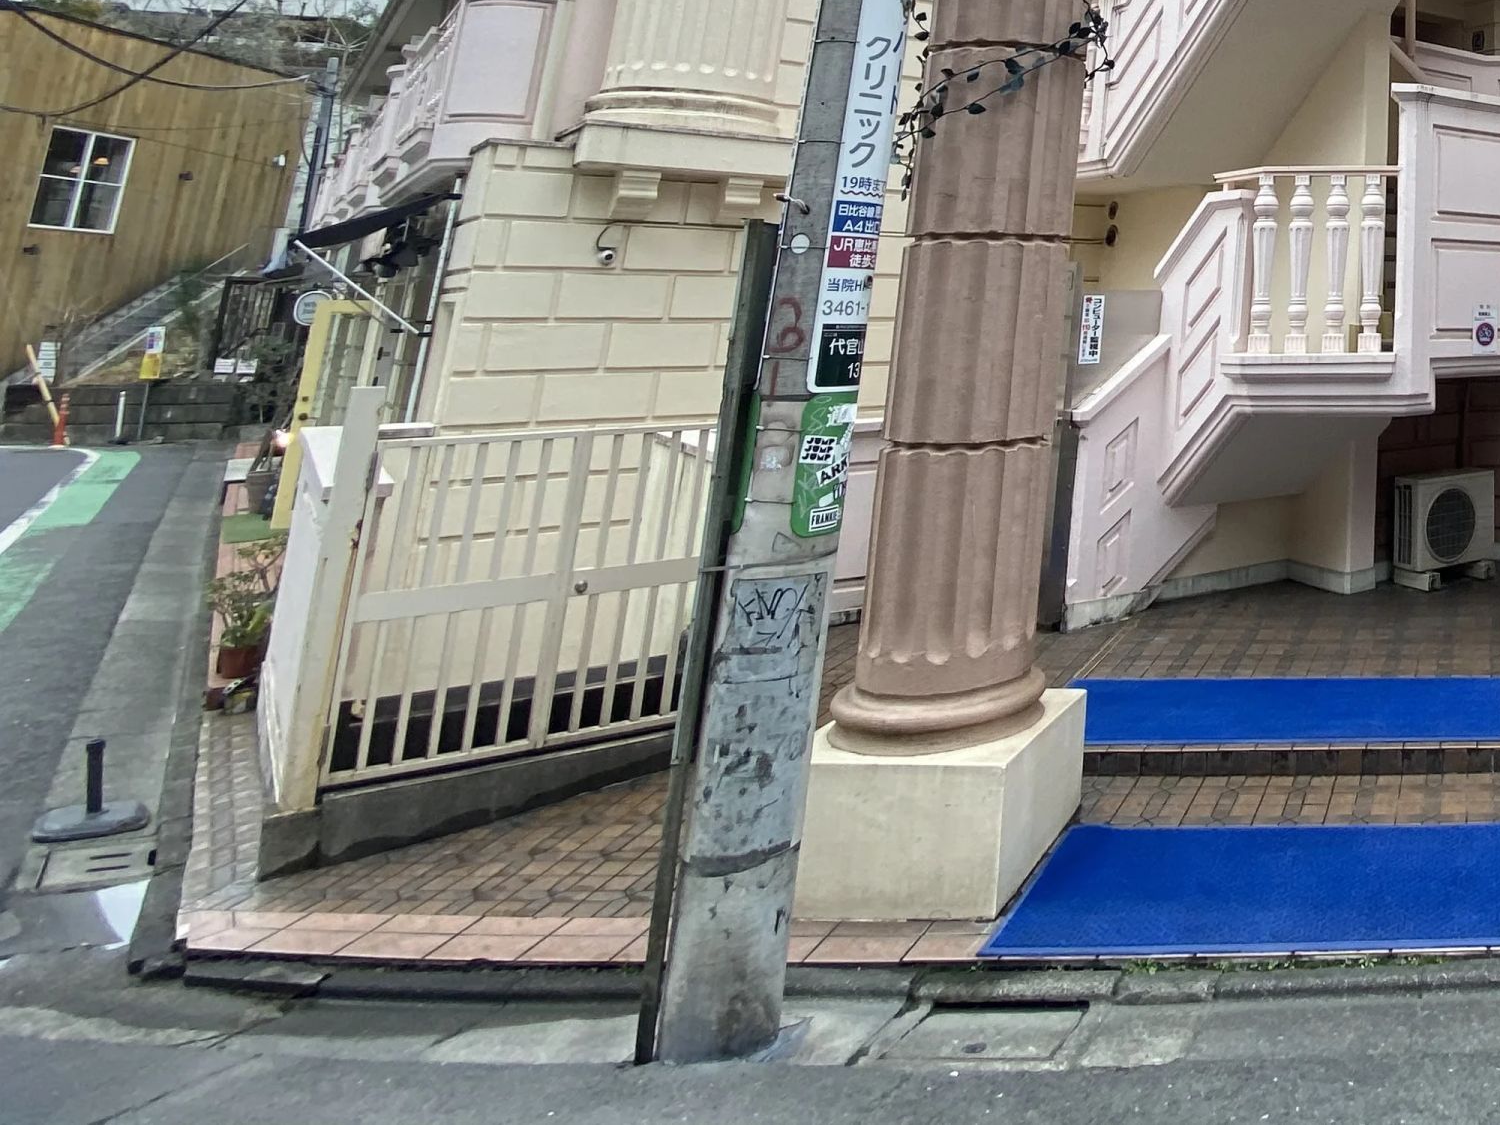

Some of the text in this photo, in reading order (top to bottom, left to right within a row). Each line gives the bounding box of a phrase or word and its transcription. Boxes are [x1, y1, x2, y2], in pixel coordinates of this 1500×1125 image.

[850, 36, 892, 168] クリニック
[826, 278, 867, 292] 当院H
[806, 437, 836, 445] JUMP
[804, 445, 834, 453] JUMP
[801, 453, 831, 461] JUMP
